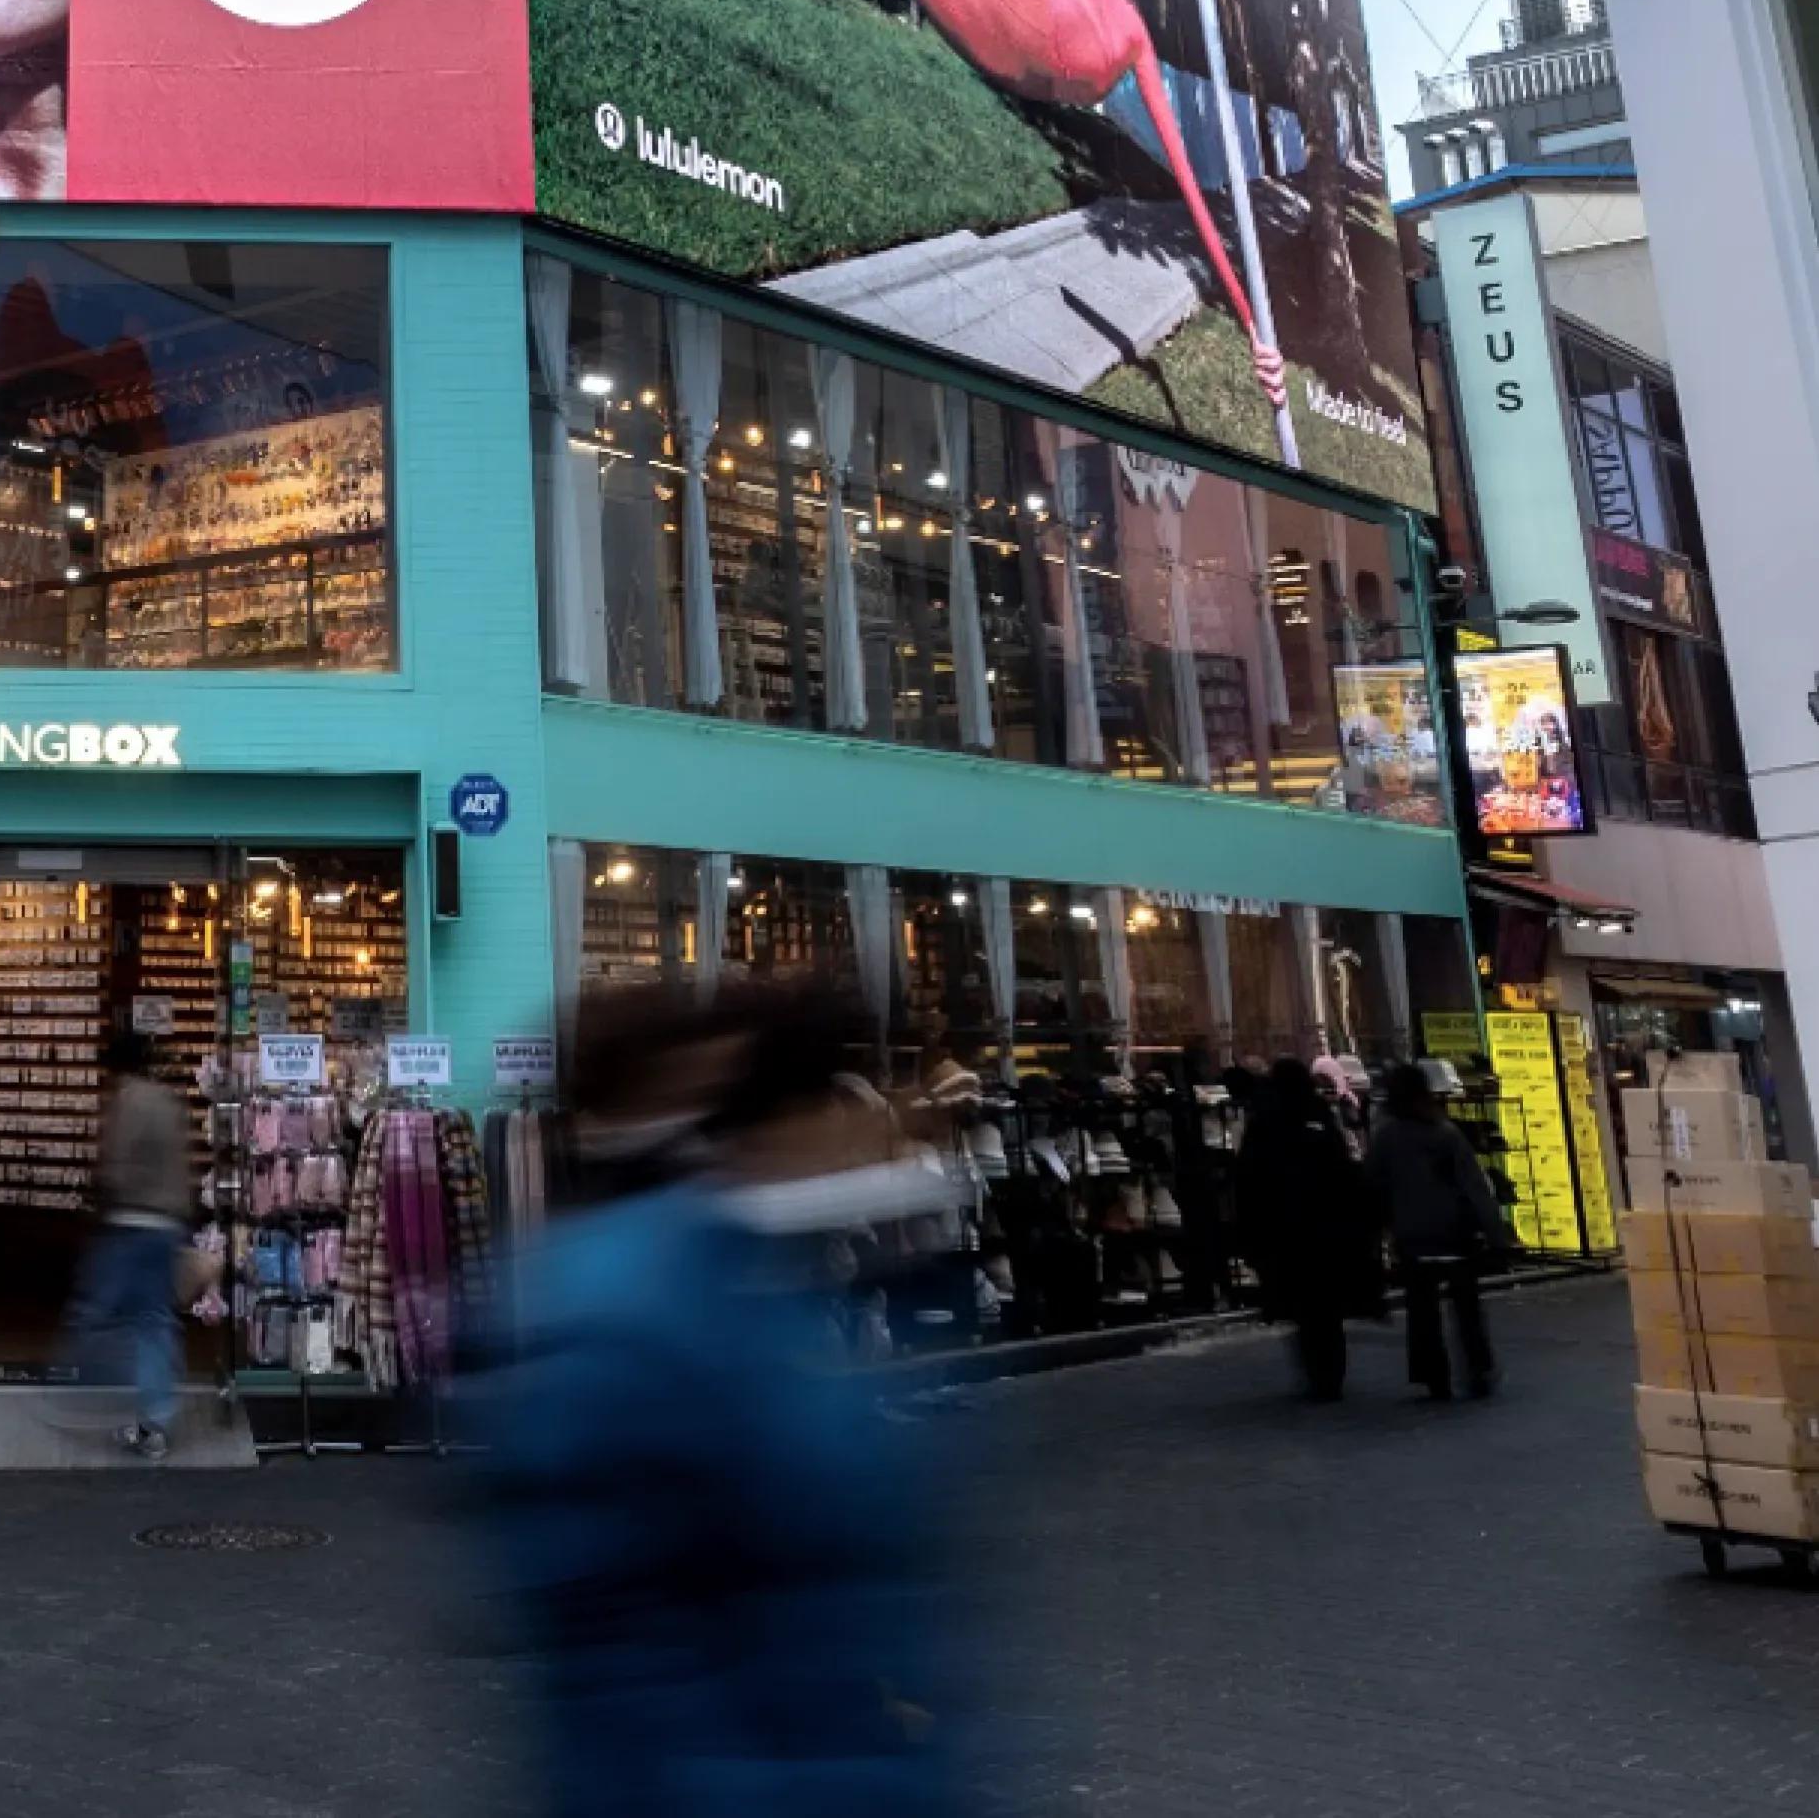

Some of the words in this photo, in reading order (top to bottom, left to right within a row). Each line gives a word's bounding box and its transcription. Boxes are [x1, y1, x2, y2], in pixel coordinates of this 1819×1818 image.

[636, 114, 784, 213] lululemon
[1469, 234, 1524, 414] ZEUS
[461, 793, 500, 816] ADT
